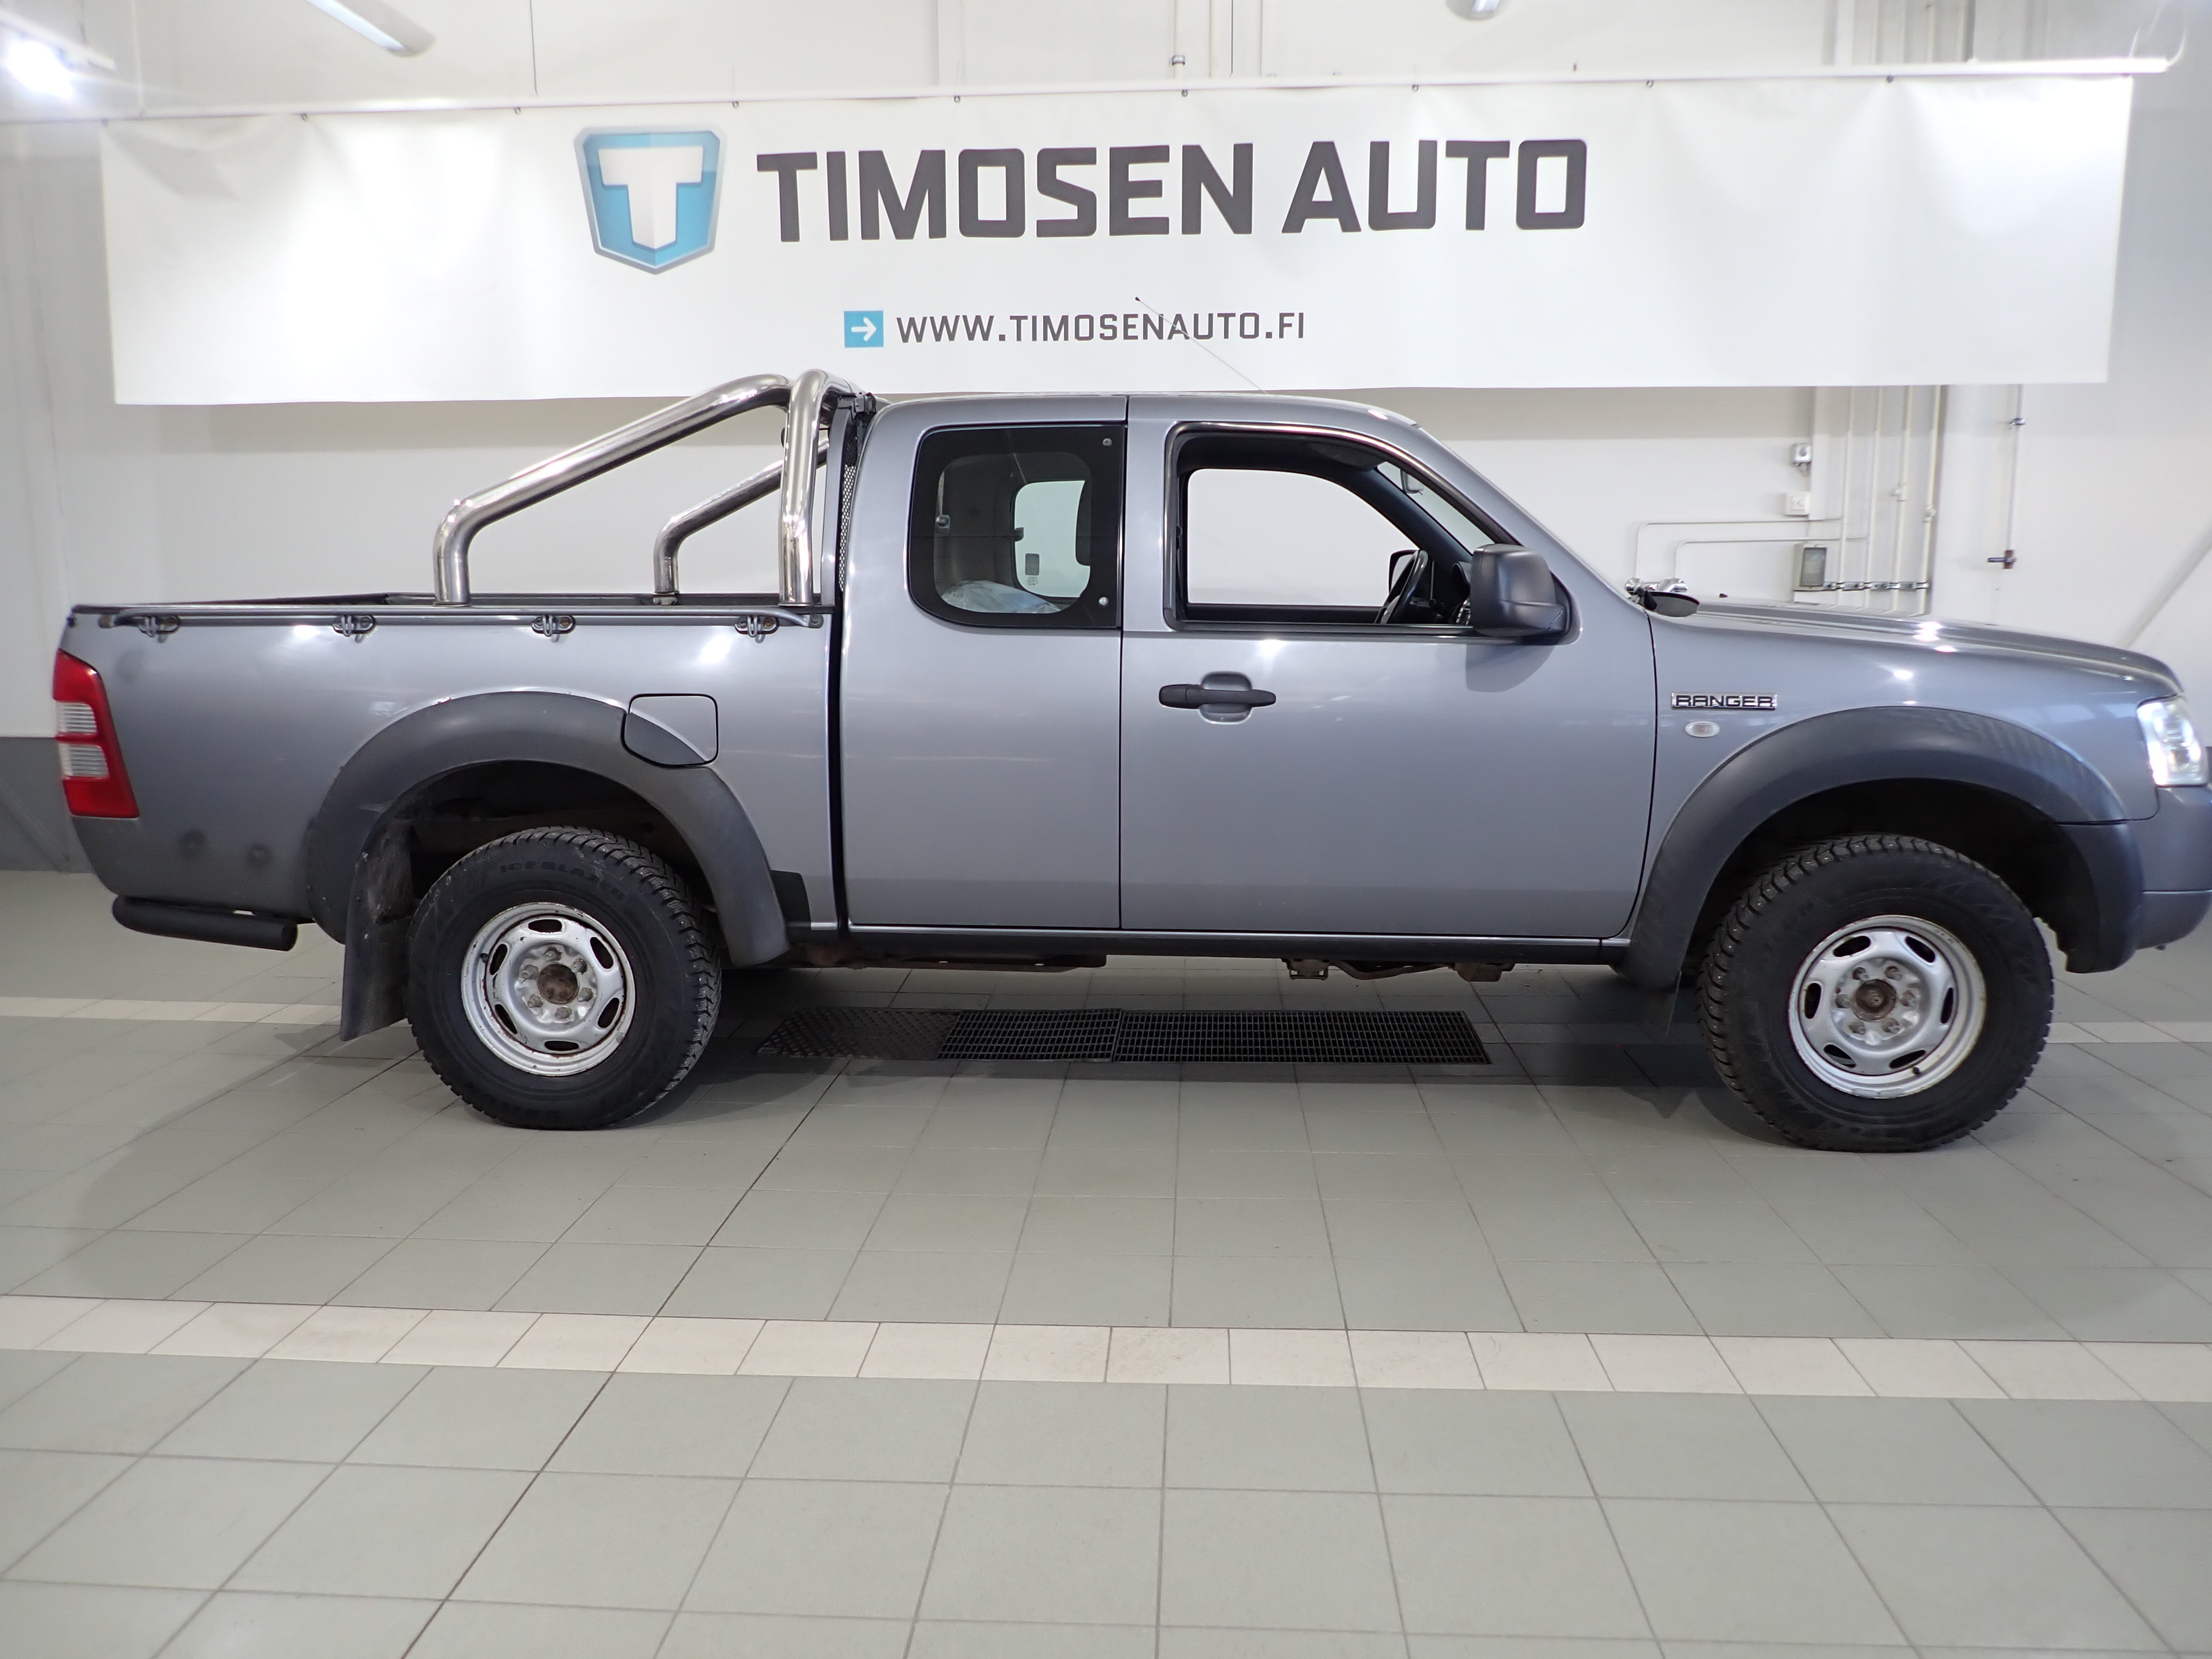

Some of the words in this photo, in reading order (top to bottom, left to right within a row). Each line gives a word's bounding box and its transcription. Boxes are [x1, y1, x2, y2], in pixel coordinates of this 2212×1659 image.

[597, 145, 703, 249] T
[757, 143, 1253, 242] TIMOSEN
[1281, 139, 1587, 233] AUTO
[896, 312, 1304, 343] WWW.TIMOSENAUTO.FI
[1675, 695, 1774, 708] RANGER
